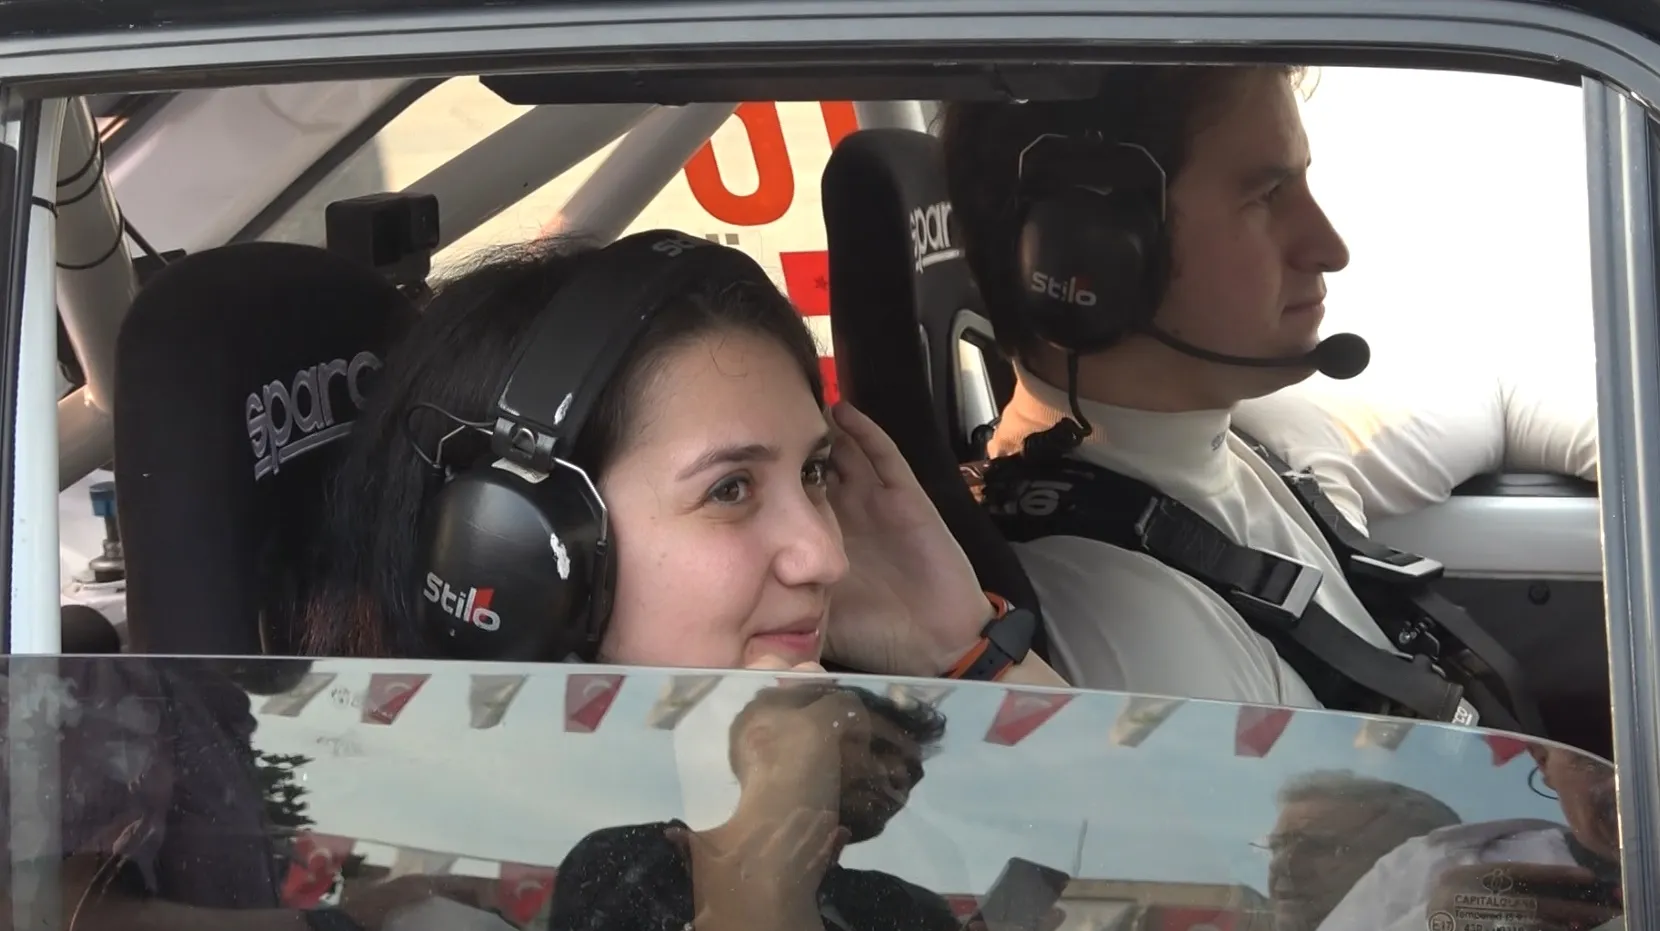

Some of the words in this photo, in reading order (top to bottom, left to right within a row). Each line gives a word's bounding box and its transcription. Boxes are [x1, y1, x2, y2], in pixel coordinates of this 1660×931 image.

[910, 201, 953, 274] spar
[1031, 271, 1097, 306] Stilo
[246, 351, 384, 477] sparc
[423, 572, 501, 631] Stilo
